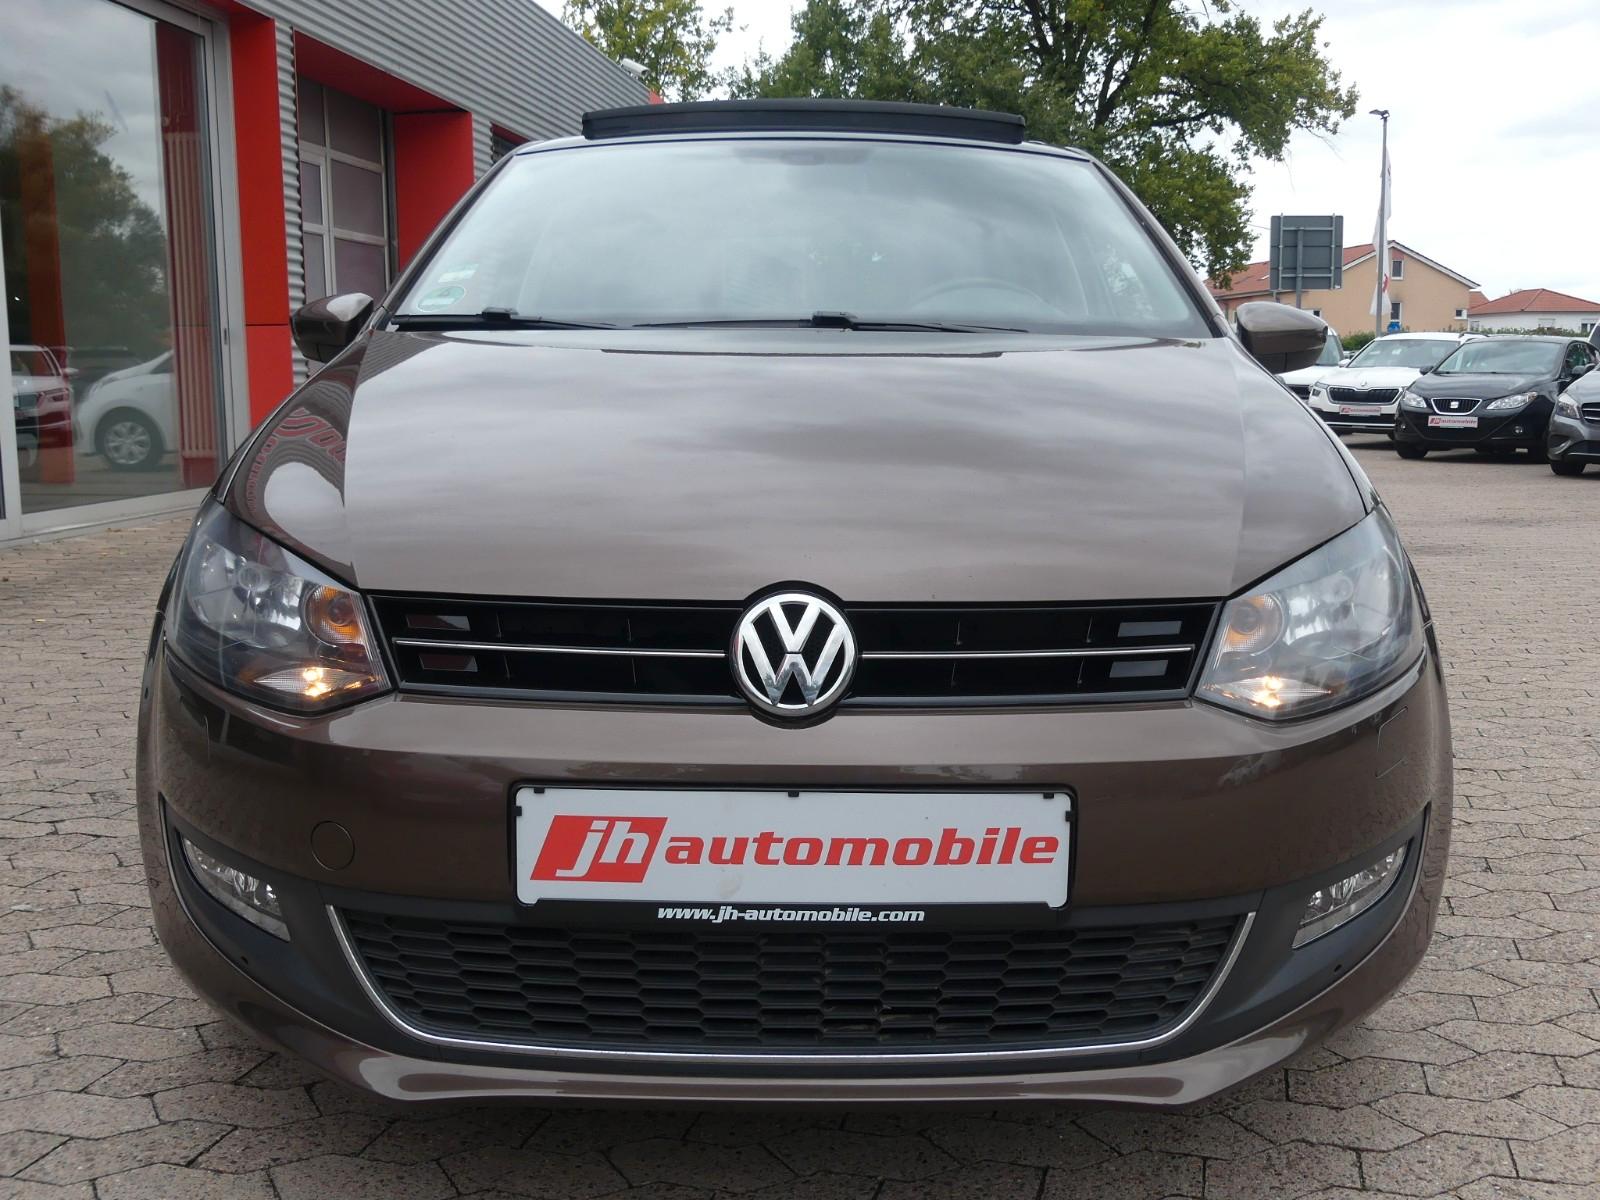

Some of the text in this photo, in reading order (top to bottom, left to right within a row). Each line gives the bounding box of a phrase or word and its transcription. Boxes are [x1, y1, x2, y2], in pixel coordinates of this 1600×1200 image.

[555, 820, 1060, 878] jh automobile
[657, 905, 926, 924] www.jh-automobile.com
